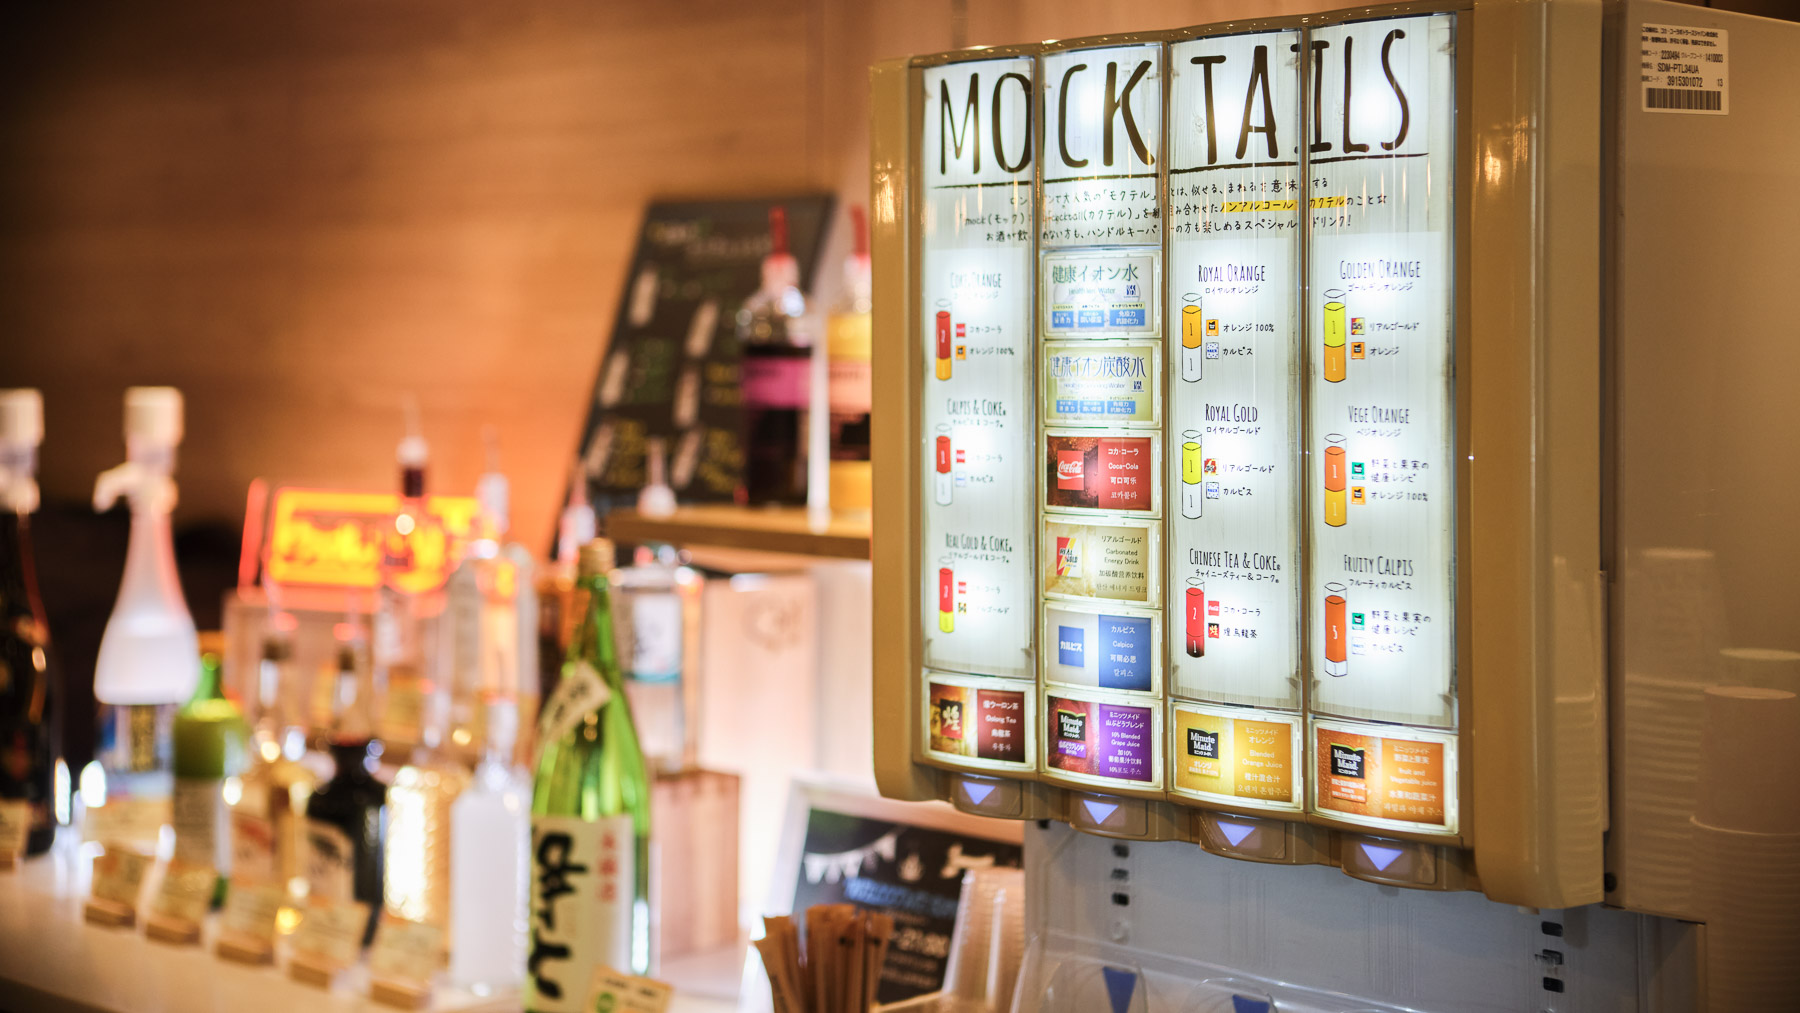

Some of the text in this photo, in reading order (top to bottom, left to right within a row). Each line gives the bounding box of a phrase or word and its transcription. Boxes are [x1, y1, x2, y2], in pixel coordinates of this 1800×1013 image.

[1052, 264, 1138, 284] 健康イオン水
[1198, 263, 1265, 282] ROYAL ORANGE
[1340, 259, 1420, 280] GOLDEN ORANGE
[1205, 285, 1259, 294] ロイヤルオレンジ
[1223, 323, 1275, 332] オレンジ 100%
[1369, 322, 1419, 331] リアルゴールド
[1223, 346, 1253, 356] カルピス
[1370, 346, 1399, 356] オレンジ
[1050, 356, 1146, 378] 健康イオン炭酸水
[1205, 403, 1258, 423] ROYAL GOLD
[1348, 405, 1410, 424] VEGE ORANGE
[1206, 426, 1261, 435] ロイヤルゴールド
[1107, 448, 1139, 456] コカ・コーラ
[1108, 462, 1139, 470] Coca-Cola
[1222, 464, 1275, 473] リアルゴールド
[1110, 477, 1137, 485] 可口可乐
[1223, 486, 1253, 496] カルピス
[1371, 491, 1428, 502] オレンジ 100%
[1101, 535, 1142, 544] リアルゴールド
[1106, 548, 1138, 556] Carbonated
[1104, 557, 1123, 565] Energy
[1189, 548, 1221, 567] CHINESE
[1224, 551, 1239, 568] TEA
[1242, 552, 1250, 569] &
[1344, 554, 1414, 576] FRUITY CALPIS
[1111, 626, 1136, 634] カルピス
[1060, 641, 1083, 652] カルピス
[1121, 732, 1141, 740] Blended
[1190, 731, 1215, 744] Minute
[1248, 736, 1275, 745] オレンジ
[1127, 740, 1140, 748] Juice
[1193, 741, 1212, 752] Maid
[1249, 749, 1275, 758] Blended
[1334, 748, 1361, 762] Minute
[1242, 758, 1283, 769] Orange Juice
